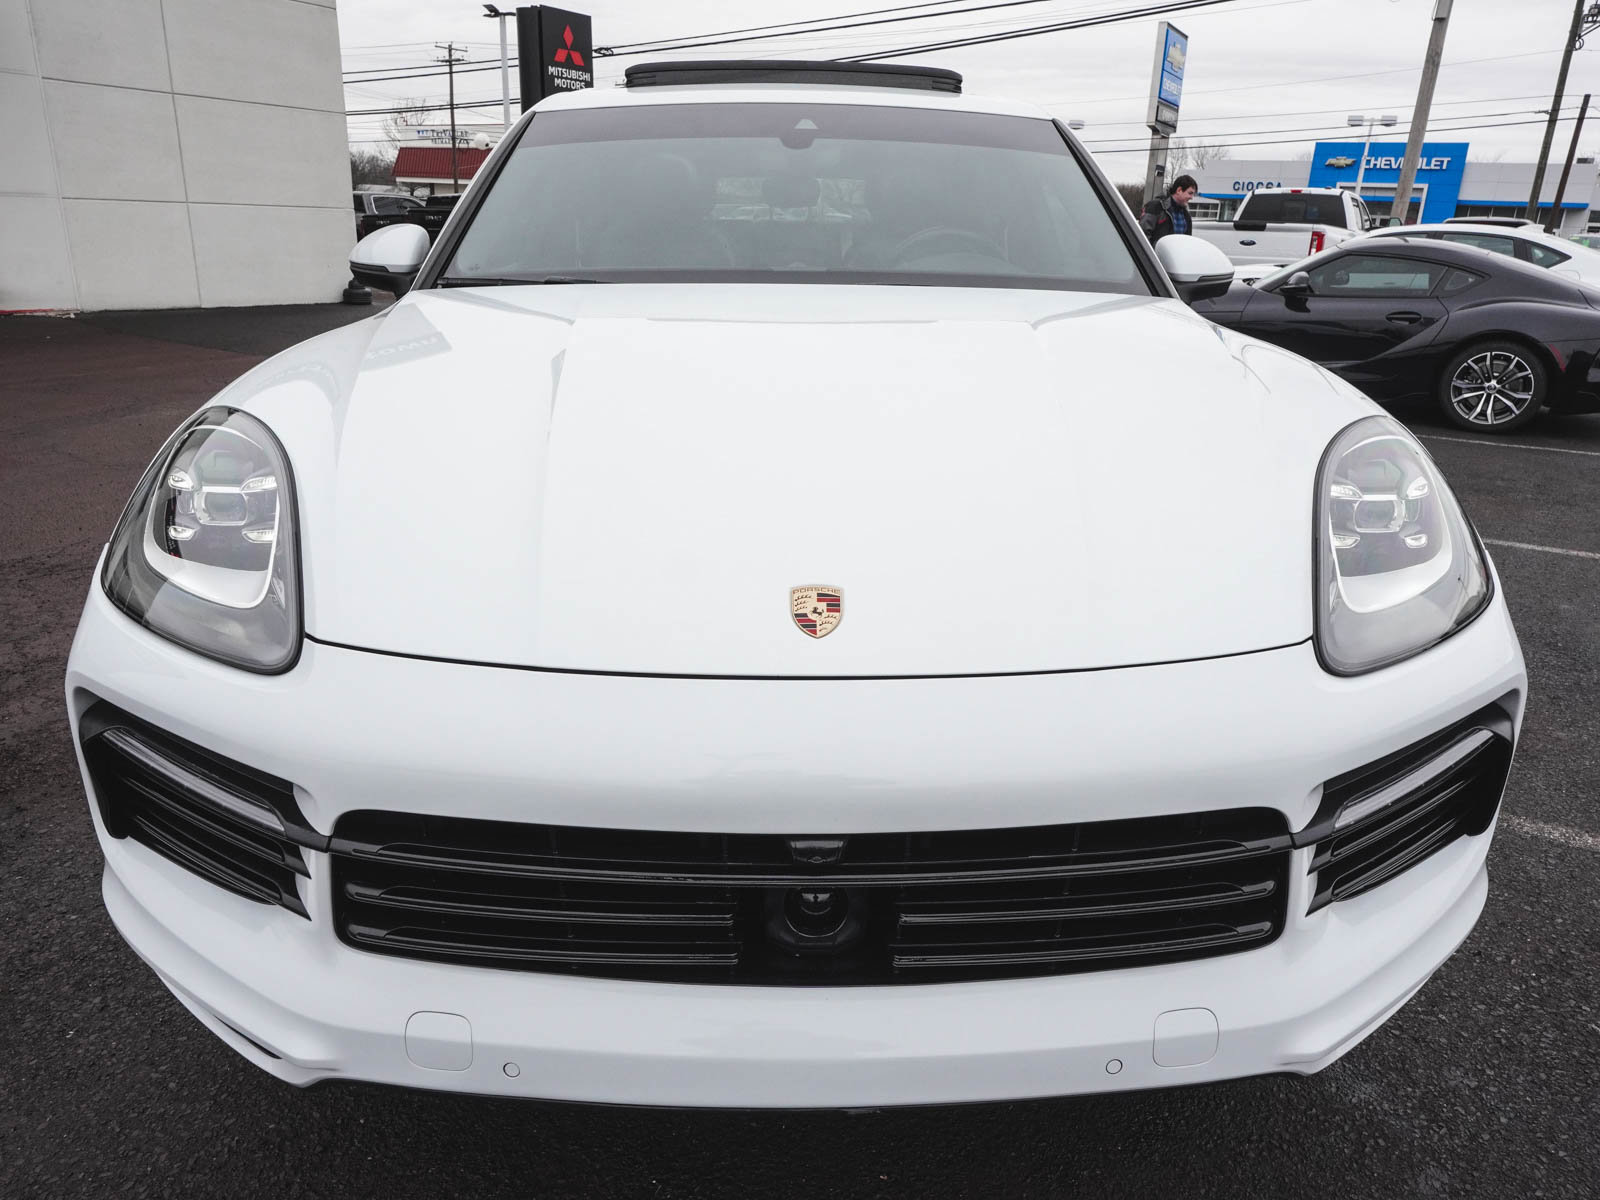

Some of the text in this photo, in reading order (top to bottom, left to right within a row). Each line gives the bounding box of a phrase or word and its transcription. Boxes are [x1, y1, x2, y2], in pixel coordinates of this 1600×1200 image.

[548, 65, 591, 82] MITSUBISHI
[554, 78, 586, 90] MOTORS
[1363, 156, 1452, 170] CHEVLET
[1232, 181, 1282, 192] CIOCCA
[792, 587, 841, 595] PORSCHE
